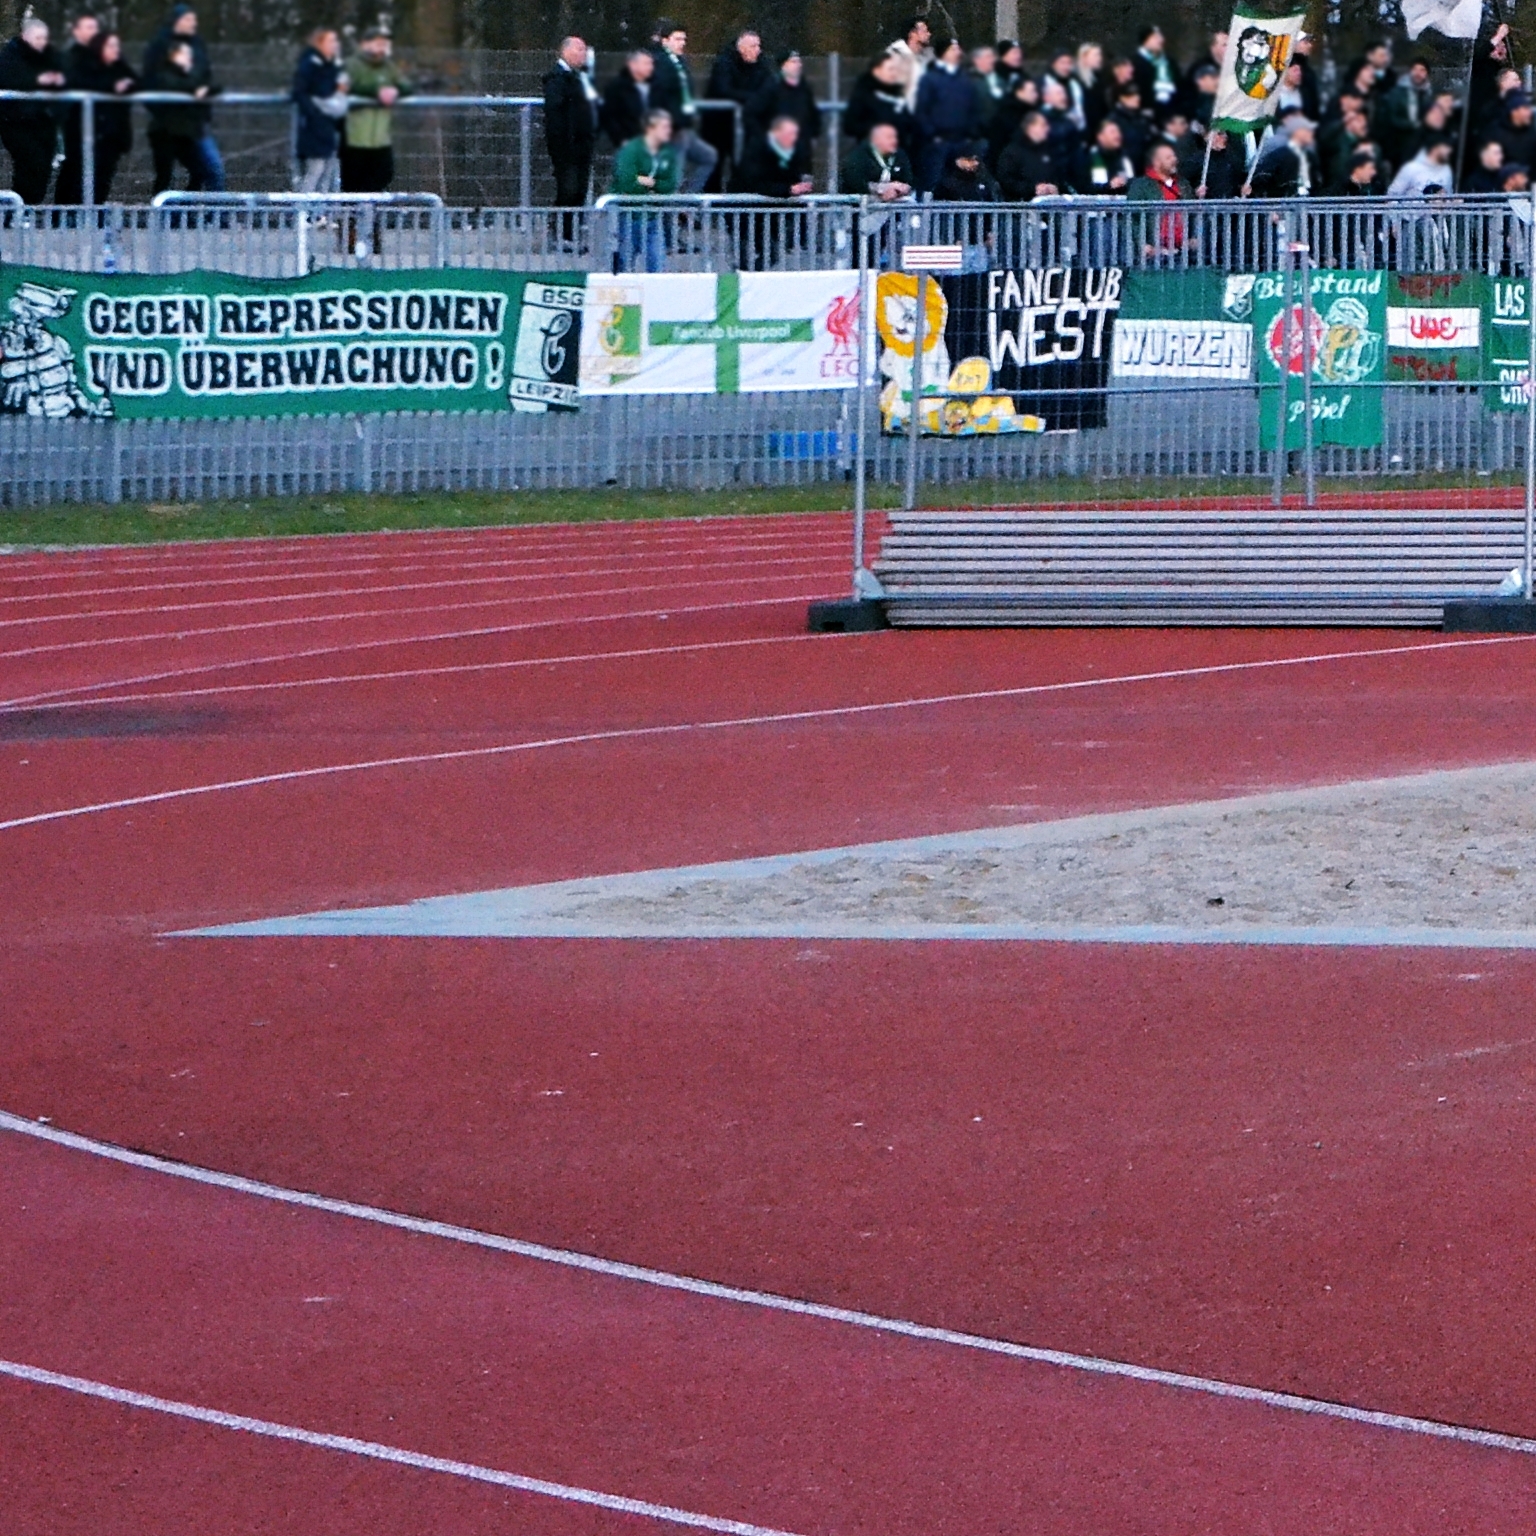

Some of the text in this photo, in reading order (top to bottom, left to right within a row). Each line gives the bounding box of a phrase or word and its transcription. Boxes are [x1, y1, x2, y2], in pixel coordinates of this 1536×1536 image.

[541, 288, 585, 306] BSG
[987, 266, 1121, 310] FANCLUB
[1494, 282, 1525, 316] LAS
[87, 293, 504, 337] GEGEN REPRESSIONEN
[987, 298, 1121, 372] WEST
[88, 350, 168, 390] UND
[181, 339, 475, 391] ÜBERWACHUNG
[1120, 326, 1250, 369] WURZEN
